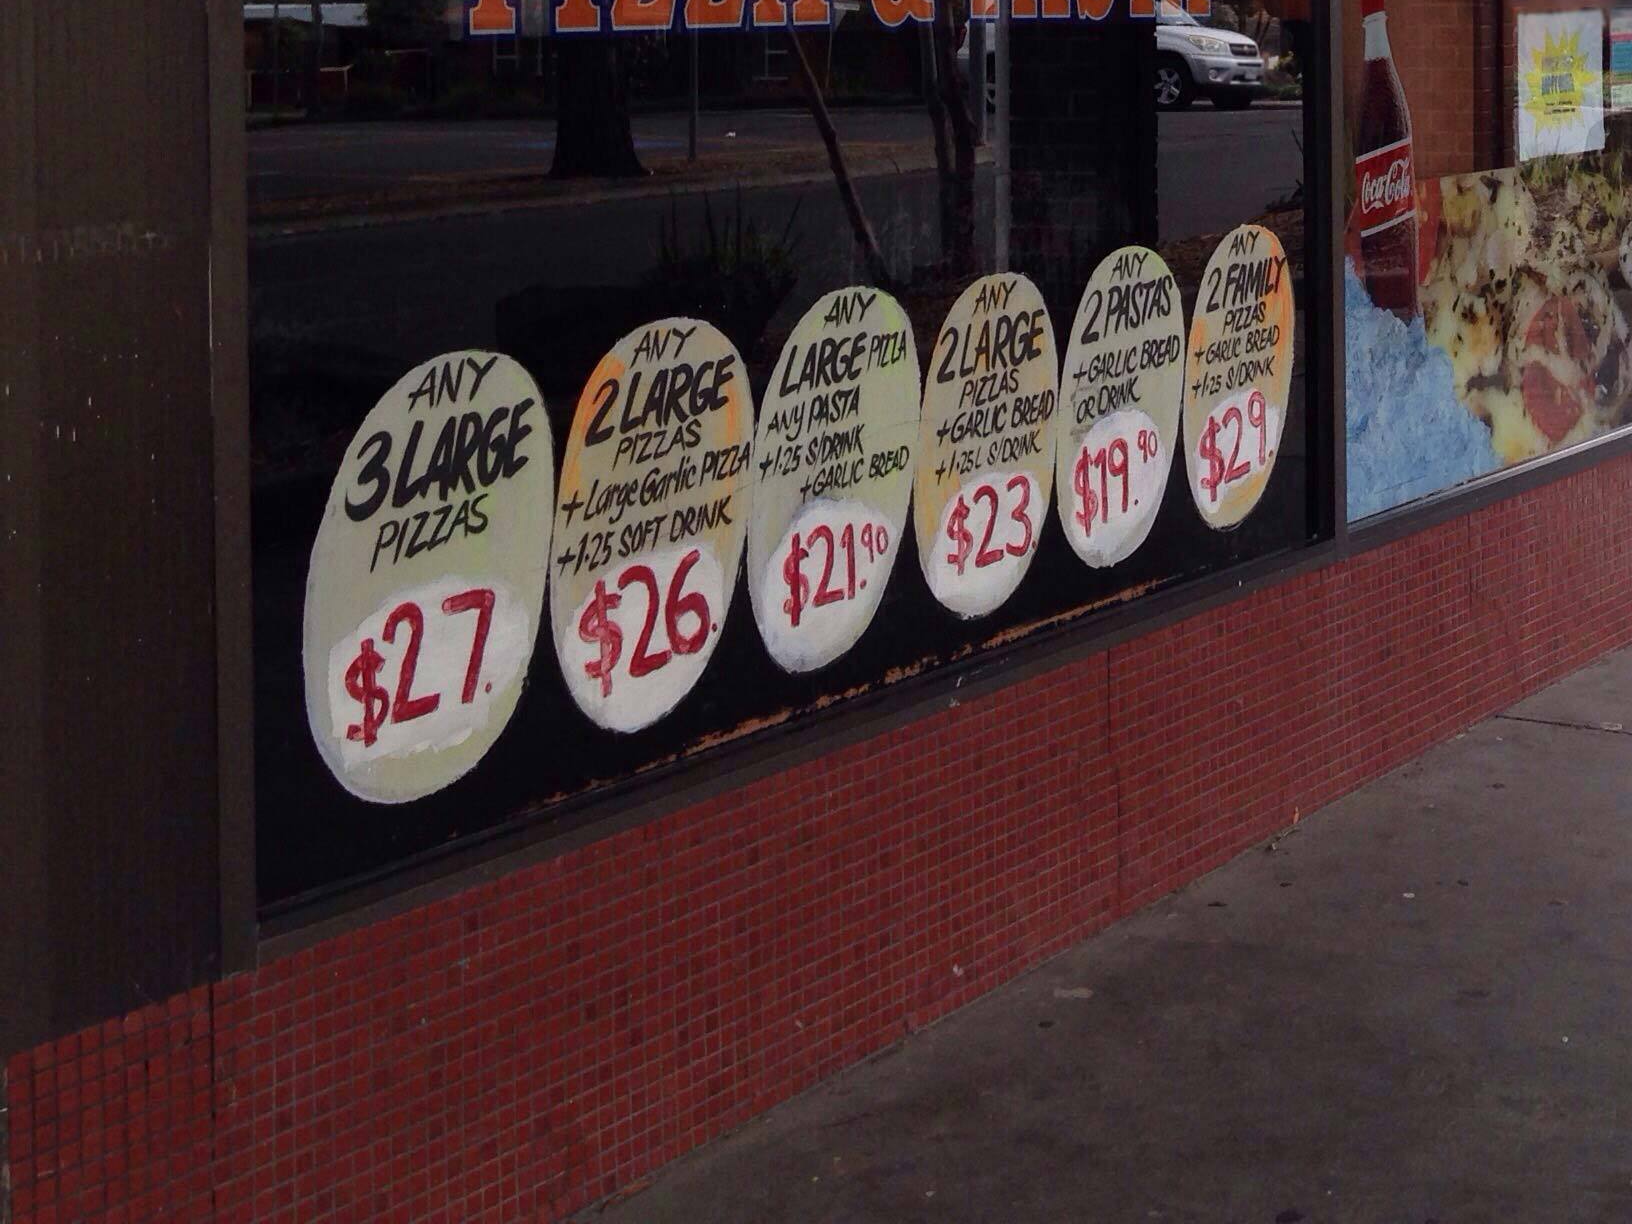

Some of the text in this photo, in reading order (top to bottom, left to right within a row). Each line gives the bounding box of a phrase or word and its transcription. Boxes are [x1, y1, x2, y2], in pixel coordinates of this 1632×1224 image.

[1111, 252, 1149, 280] ANY
[1229, 230, 1259, 259] ANY
[973, 280, 1016, 313] ANY
[1102, 273, 1171, 337] PASTAS
[1222, 255, 1286, 309] FAMILY
[823, 292, 876, 328] ANY
[1224, 302, 1266, 337] PIZZAS
[629, 327, 698, 368] ANY
[779, 329, 907, 399] LARGE PIZZA
[960, 309, 1044, 378] LARGE
[1140, 337, 1179, 370] BREAD
[1244, 325, 1280, 355] BREAD
[409, 356, 497, 413] ANY
[621, 354, 736, 434] LARGE
[960, 368, 1019, 407] PIZZAS
[1011, 388, 1054, 426] BREAD
[1076, 378, 1142, 424] OR DRINK
[768, 386, 861, 442] ANY PASTA
[392, 397, 534, 512] LARGE
[614, 420, 701, 470] PIZZAS
[868, 445, 910, 483] BREAD
[638, 458, 696, 508] Garlic
[699, 441, 751, 485] PIZZA
[370, 493, 489, 573] PIZZAS
[618, 513, 666, 560] SOFT
[669, 495, 733, 543] DRINK
